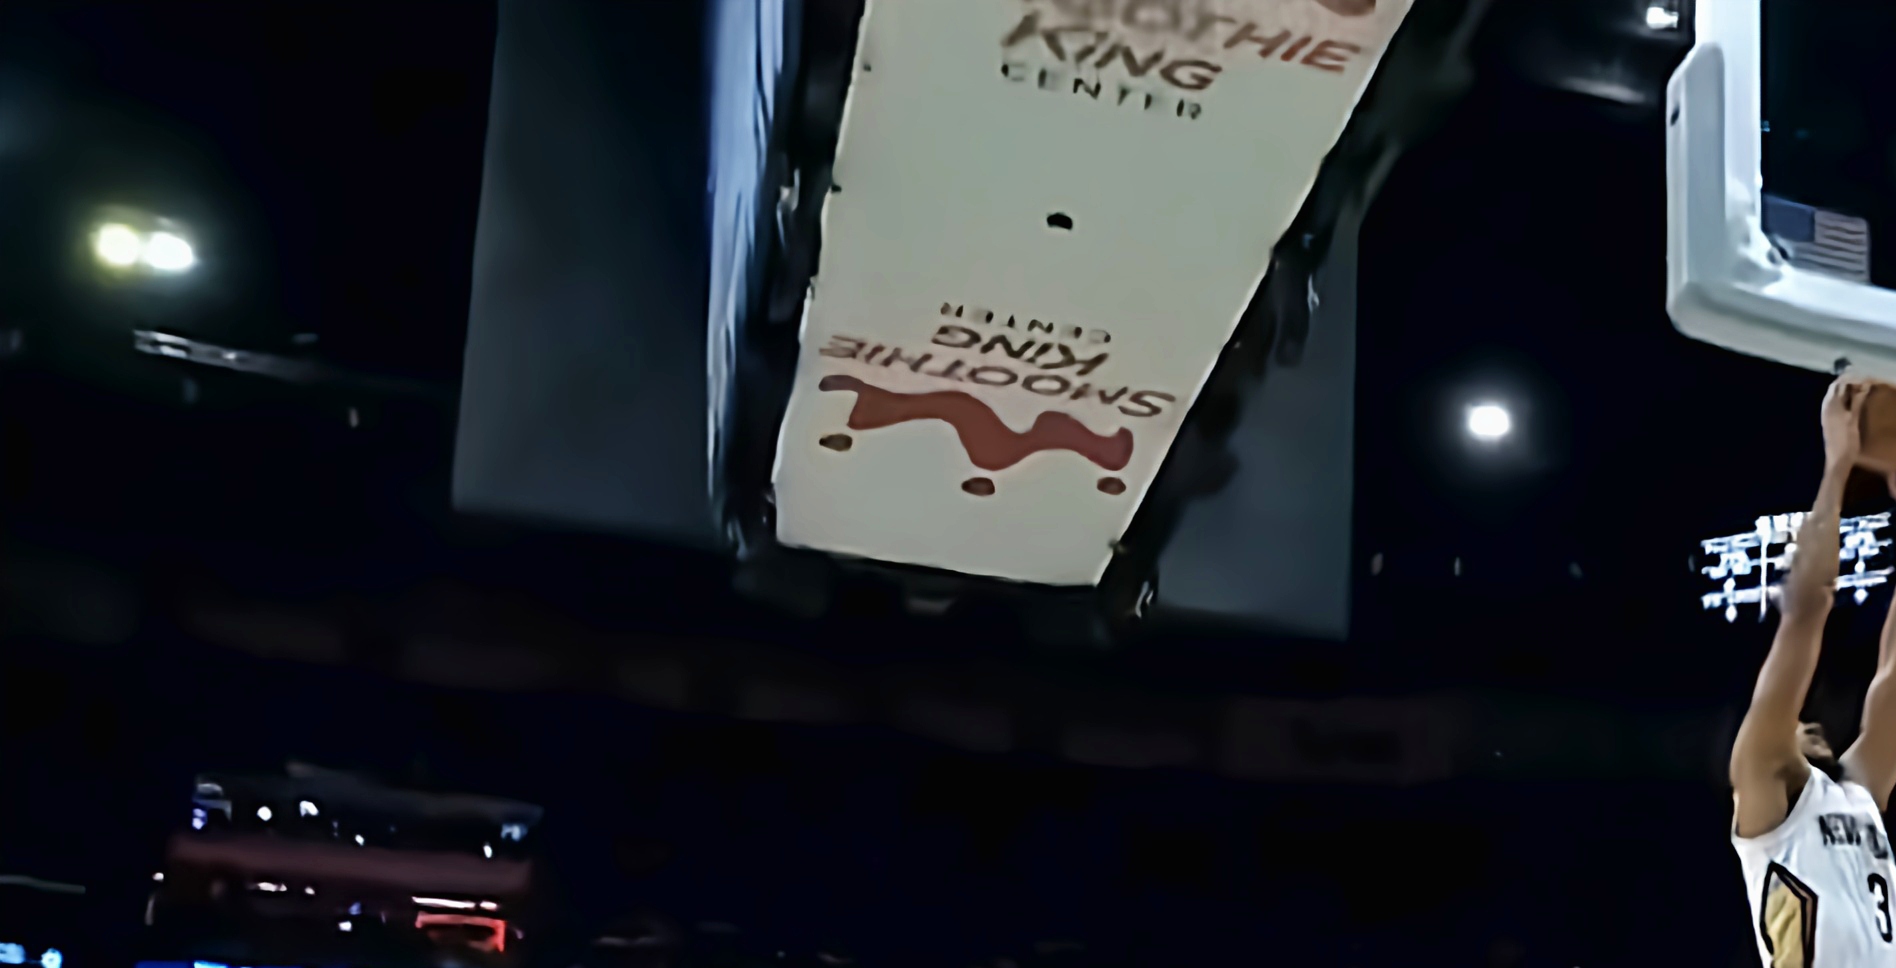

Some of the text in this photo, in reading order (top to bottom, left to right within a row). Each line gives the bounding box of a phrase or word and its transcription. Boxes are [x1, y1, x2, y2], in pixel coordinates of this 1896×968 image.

[1000, 10, 1223, 91] KING
[818, 334, 1177, 418] SMOOTHIE
[930, 324, 1110, 377] KING
[1867, 872, 1893, 943] 3
